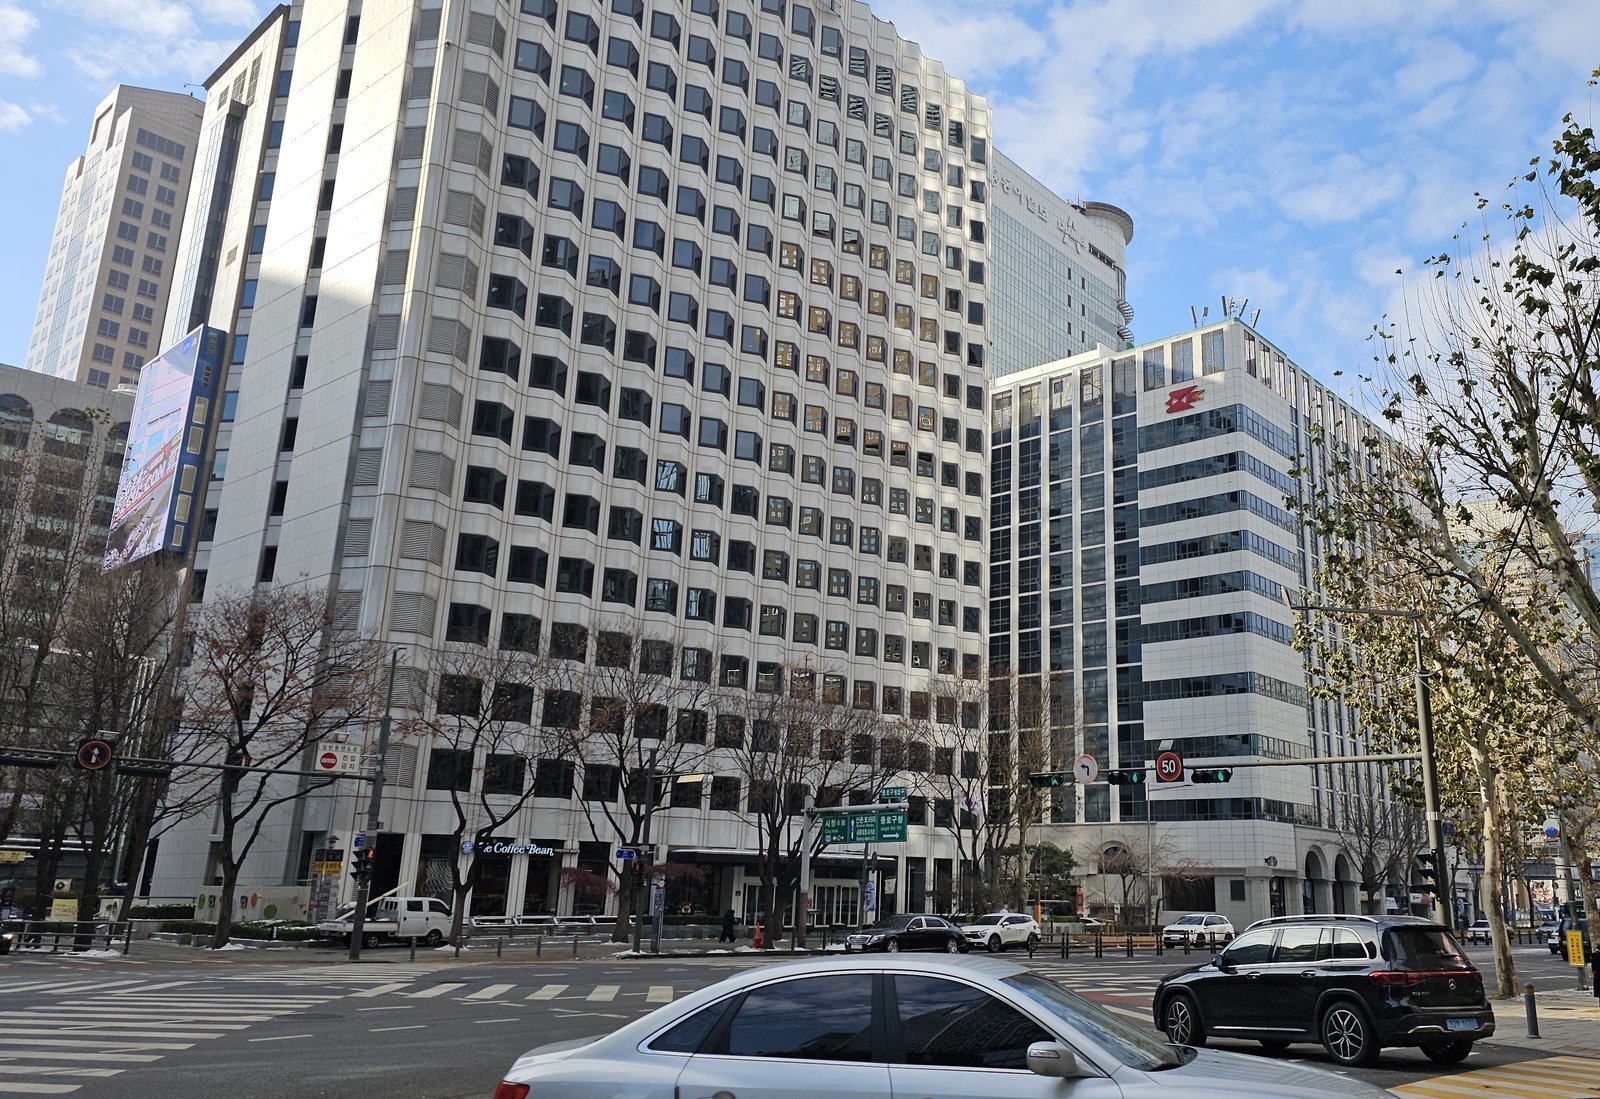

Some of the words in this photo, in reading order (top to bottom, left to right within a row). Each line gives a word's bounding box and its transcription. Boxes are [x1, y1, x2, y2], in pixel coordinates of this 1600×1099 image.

[1001, 177, 1048, 223] 동아일보
[342, 754, 356, 762] 진입
[341, 762, 355, 770] 금지
[1161, 759, 1176, 773] 50
[880, 815, 904, 825] 종로구청
[494, 842, 525, 854] Coffee
[526, 843, 554, 857] Bean
